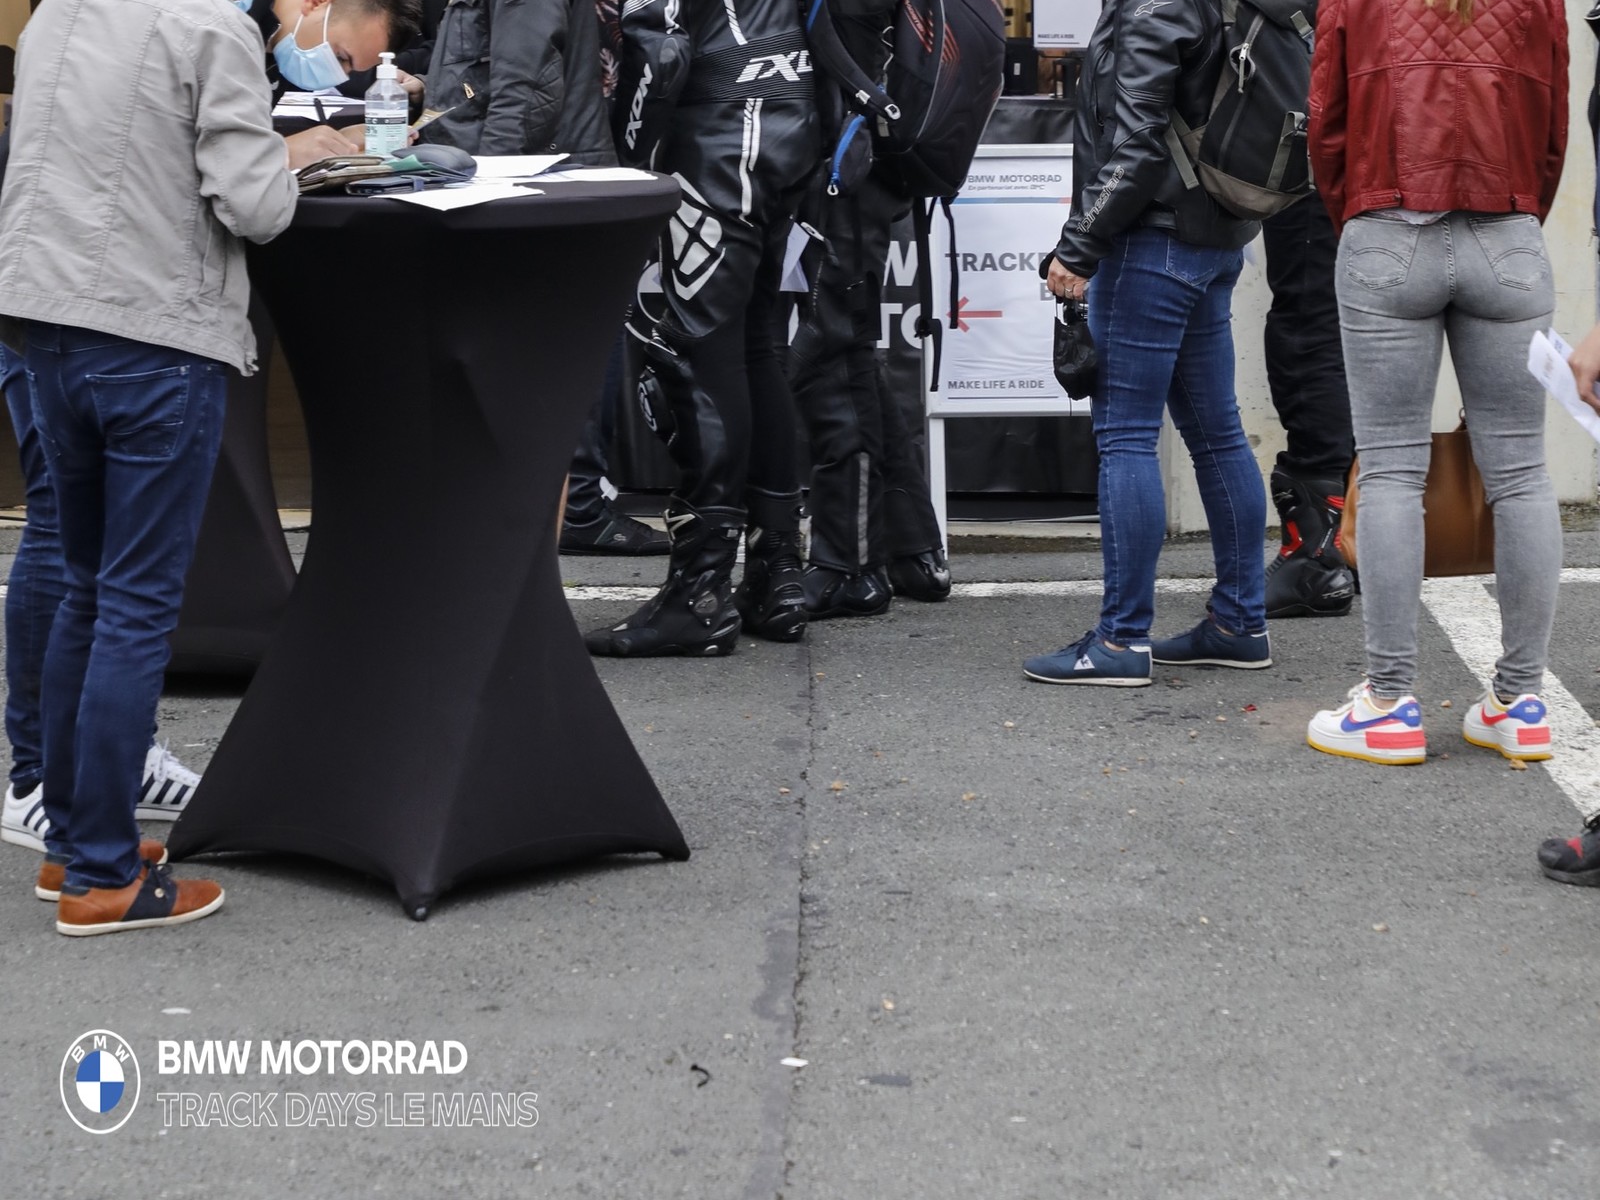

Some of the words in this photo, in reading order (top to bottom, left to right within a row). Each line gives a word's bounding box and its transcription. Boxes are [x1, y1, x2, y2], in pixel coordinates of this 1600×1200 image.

[968, 175, 996, 183] BMW
[1000, 174, 1062, 183] MOTORRAD
[948, 381, 981, 389] MAKE
[983, 381, 1006, 389] LIFE
[1020, 380, 1045, 388] RIDE
